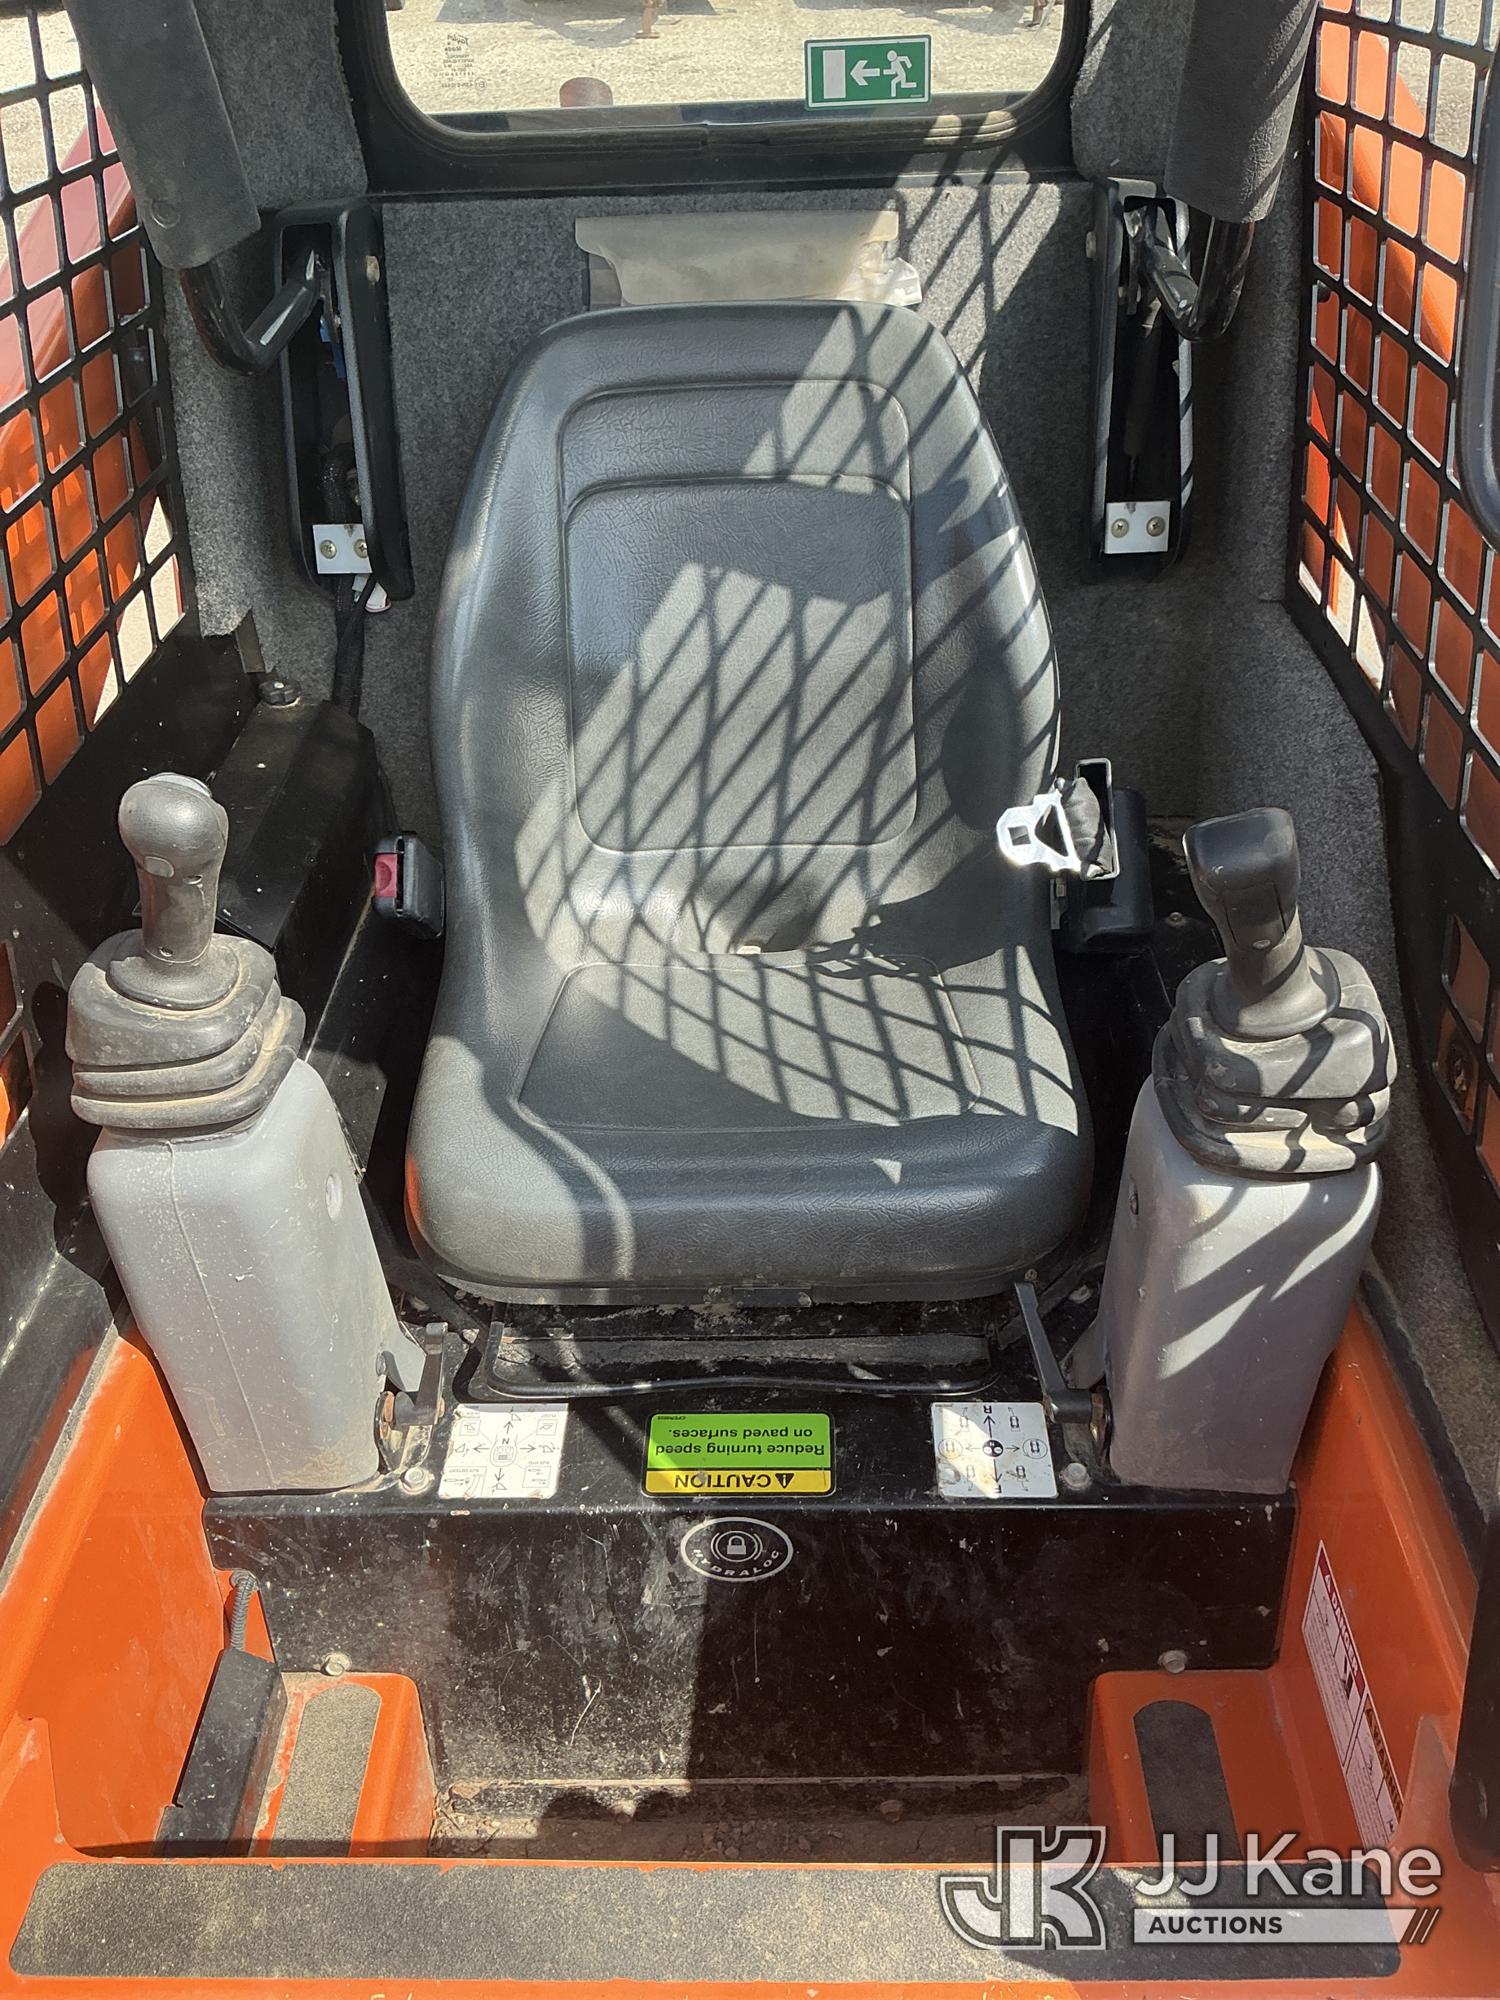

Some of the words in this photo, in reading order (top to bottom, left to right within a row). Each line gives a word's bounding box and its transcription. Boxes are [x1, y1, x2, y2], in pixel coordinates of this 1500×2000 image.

[983, 1405, 992, 1413] R
[668, 1429, 738, 1440] surfaces.
[743, 1426, 788, 1439] paved
[794, 1429, 813, 1438] on
[655, 1443, 702, 1456] speed
[707, 1442, 762, 1455] turning
[766, 1444, 825, 1455] Reduce
[674, 1474, 771, 1488] CAUTION
[993, 1485, 1002, 1493] F
[693, 1549, 781, 1576] HYDRALOC
[1331, 1592, 1359, 1675] DANGER
[1372, 1724, 1404, 1821] WARNIN
